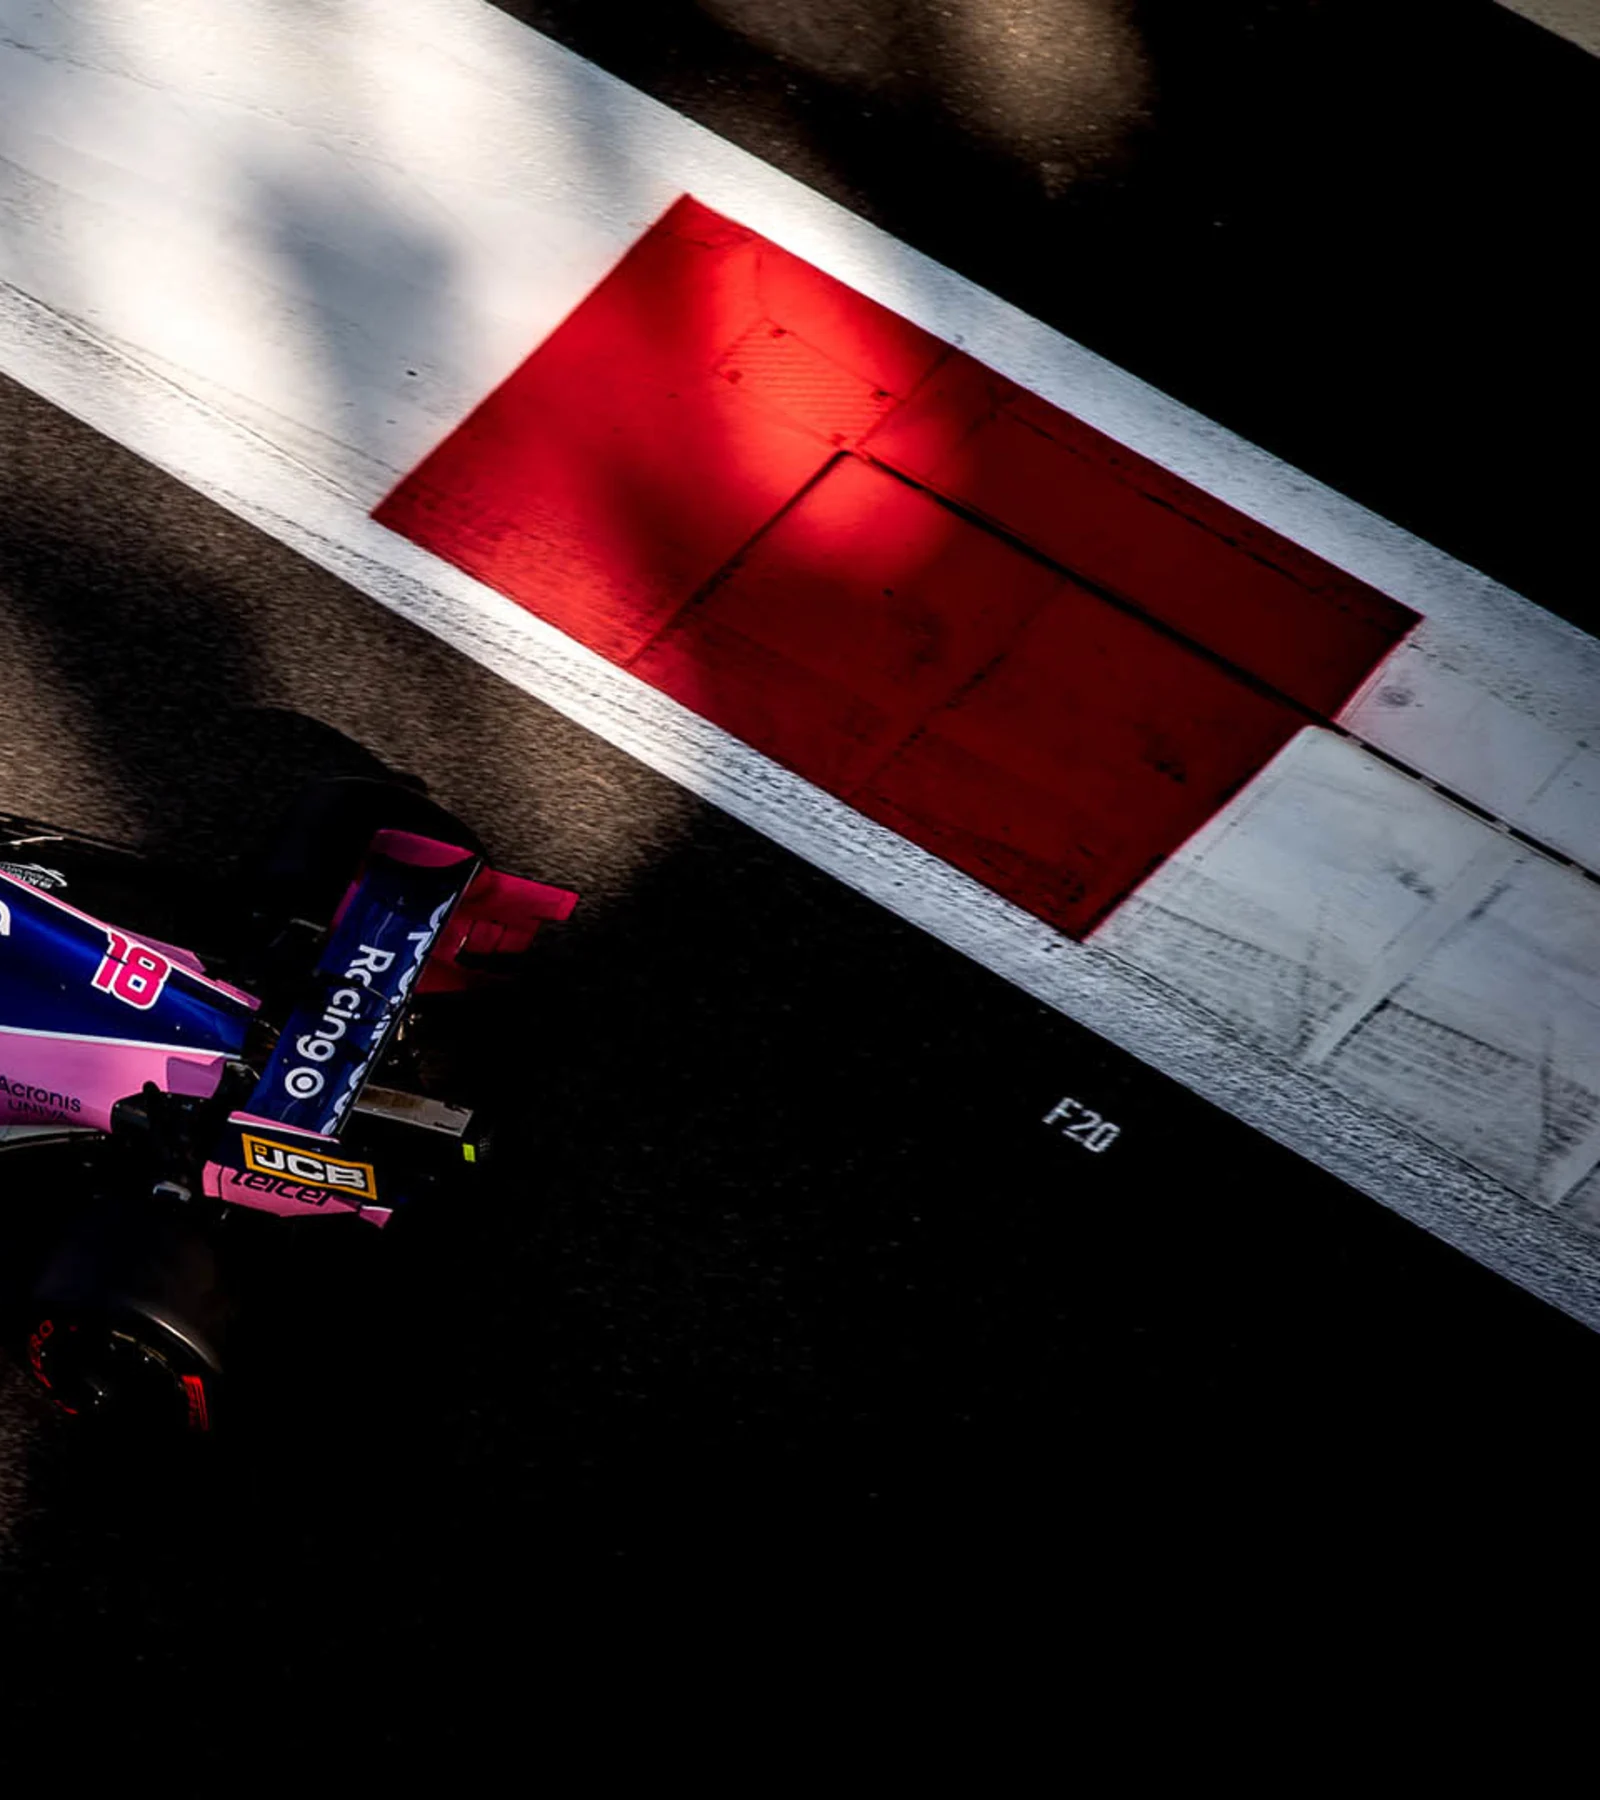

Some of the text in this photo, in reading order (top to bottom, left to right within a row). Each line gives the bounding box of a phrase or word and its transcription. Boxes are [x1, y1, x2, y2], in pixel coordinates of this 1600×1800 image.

[90, 927, 172, 1010] 18
[1042, 1097, 1122, 1152] F20
[255, 1149, 366, 1189] JCB
